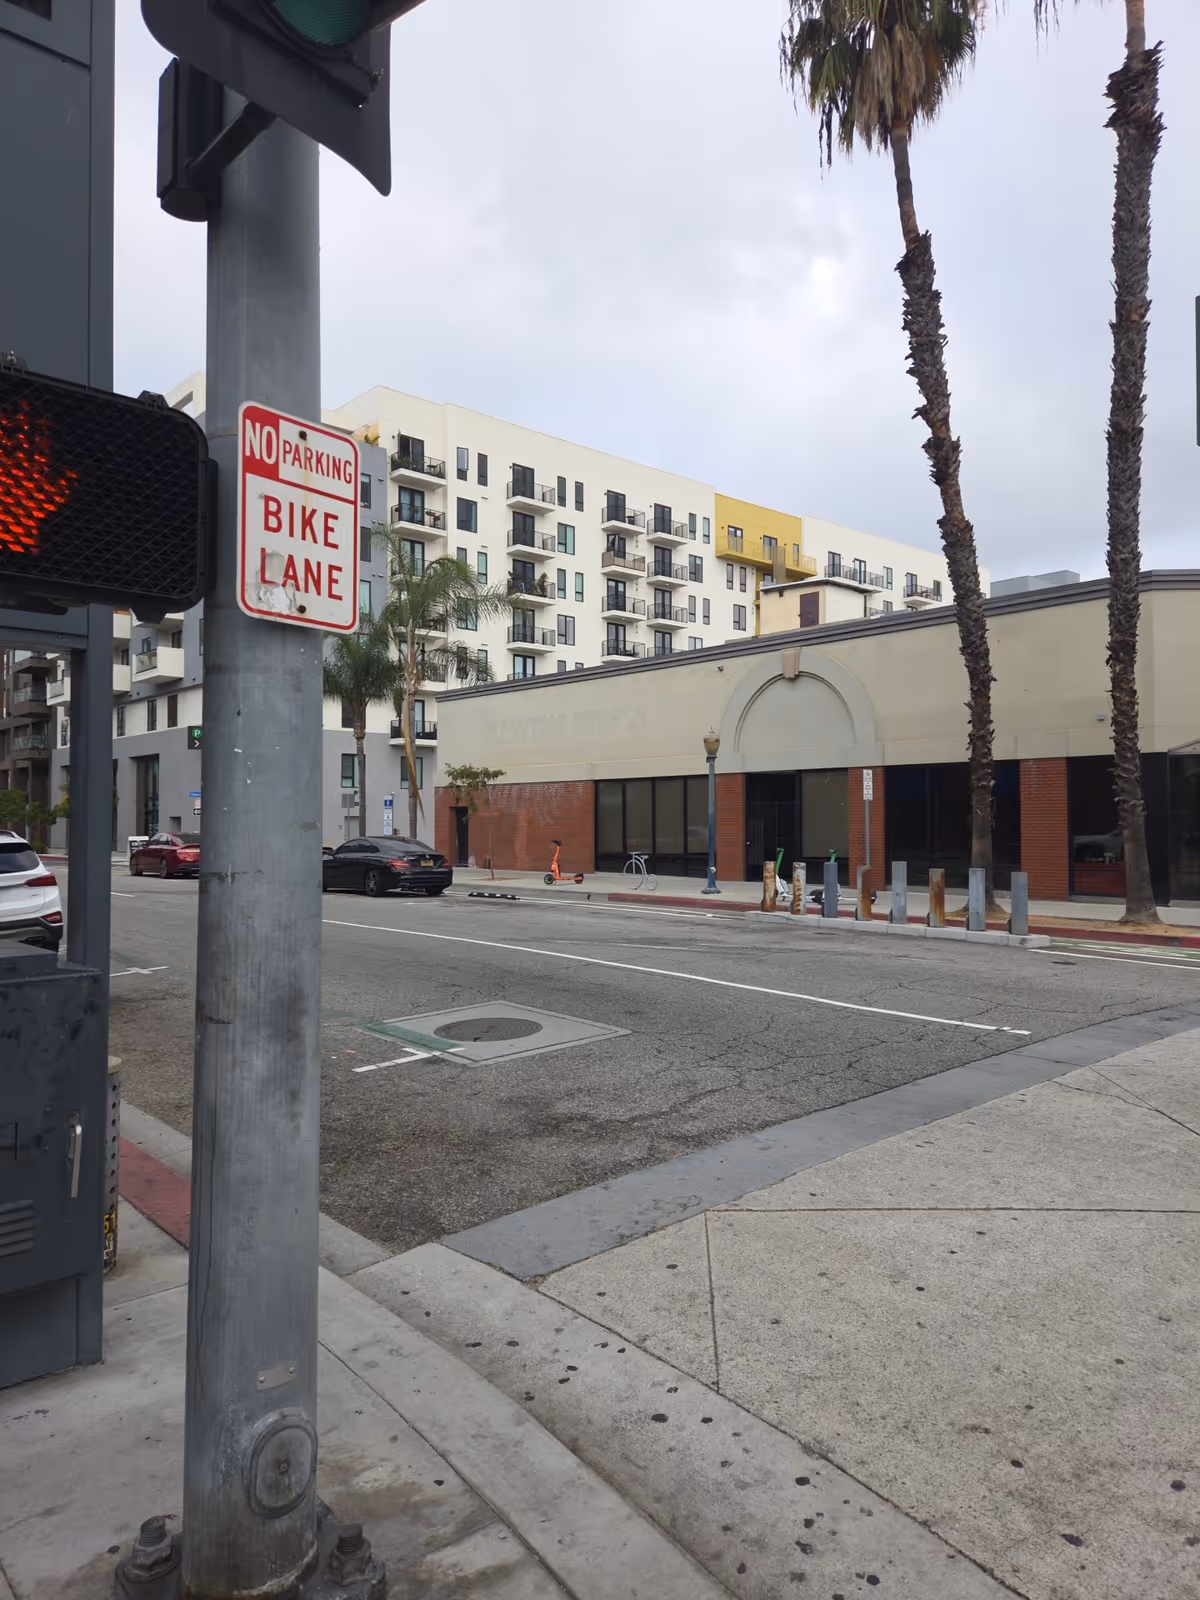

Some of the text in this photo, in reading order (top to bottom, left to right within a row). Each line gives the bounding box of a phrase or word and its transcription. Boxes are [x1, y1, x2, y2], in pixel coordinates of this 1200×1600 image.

[245, 419, 352, 485] NO PARKING
[263, 494, 338, 549] BIKE
[260, 547, 343, 601] LANE
[194, 729, 201, 737] P
